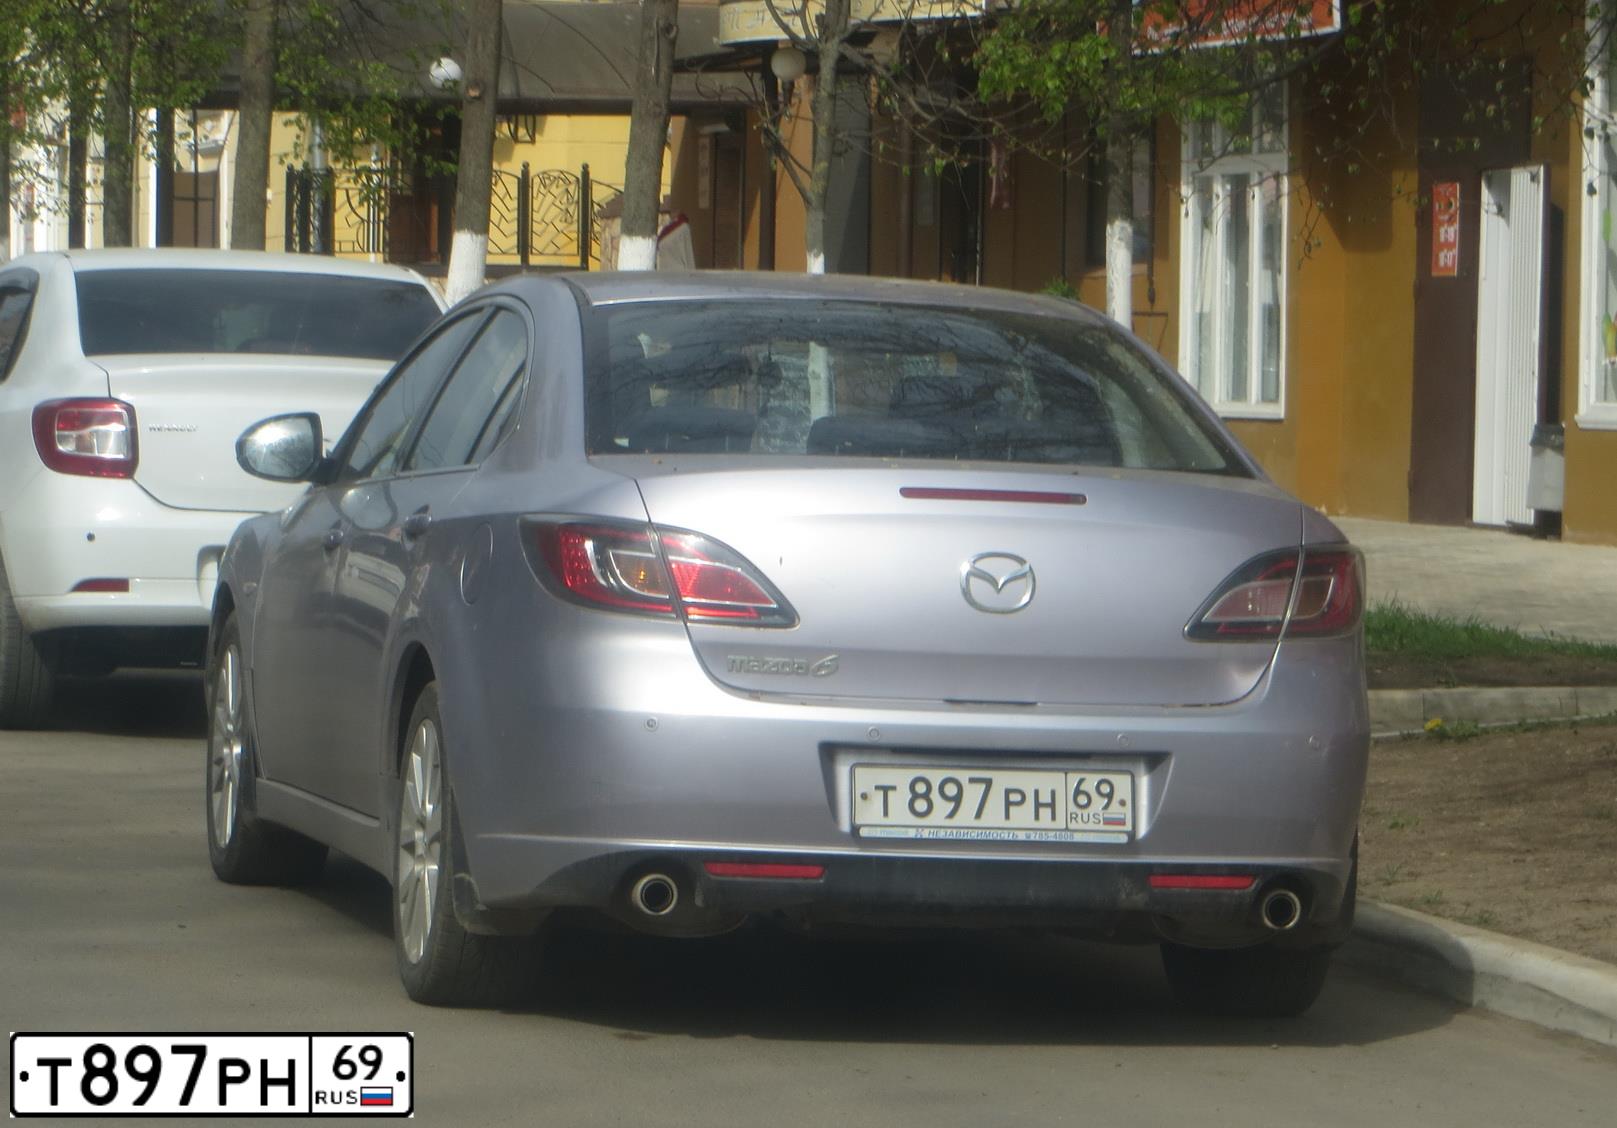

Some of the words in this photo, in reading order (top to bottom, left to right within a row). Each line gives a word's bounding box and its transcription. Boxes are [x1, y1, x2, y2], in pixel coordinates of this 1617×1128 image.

[874, 775, 1057, 822] Т897РН
[1072, 777, 1115, 810] 69
[1069, 812, 1101, 825] RUS
[927, 828, 1019, 841] НЕЗАВИСИМОСТЬ
